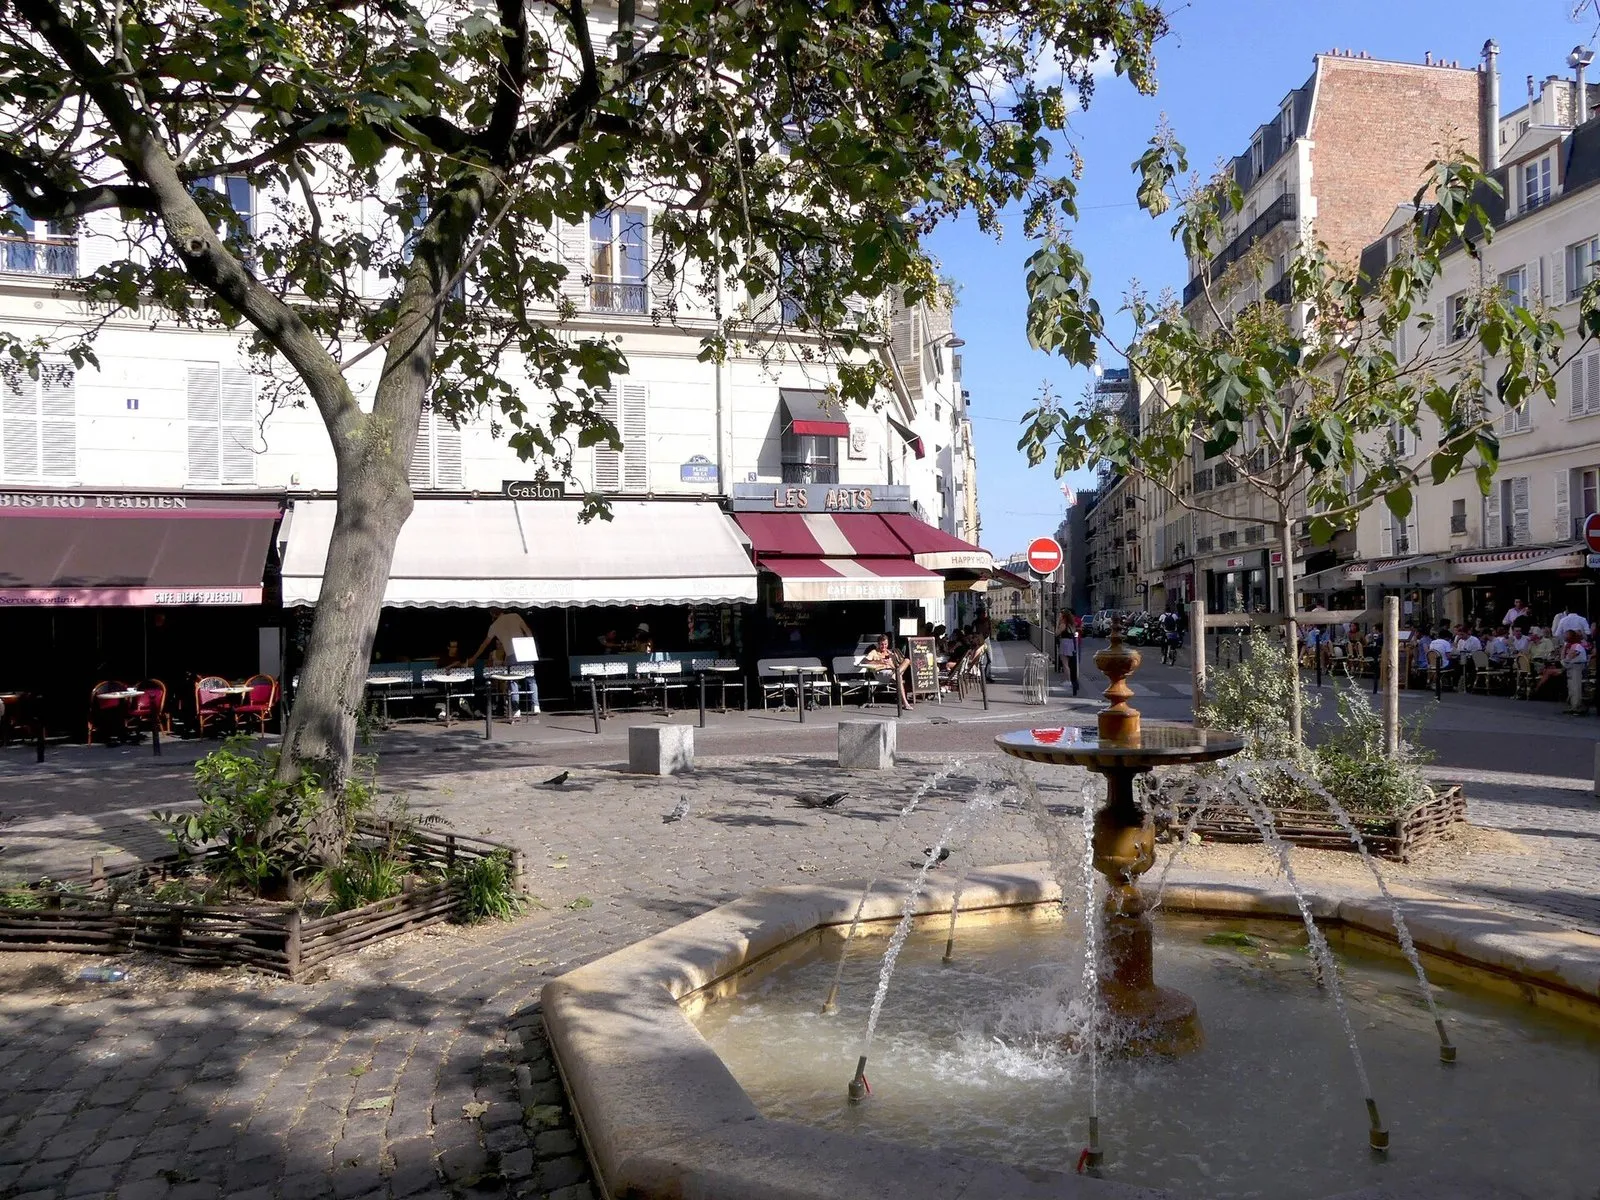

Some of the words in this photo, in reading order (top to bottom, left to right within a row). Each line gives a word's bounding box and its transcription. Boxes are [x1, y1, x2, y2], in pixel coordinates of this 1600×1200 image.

[507, 481, 561, 498] Gaston
[95, 496, 187, 509] ITALIEN
[774, 487, 808, 508] LES
[825, 487, 873, 511] ARTS
[951, 556, 975, 565] HAPPY
